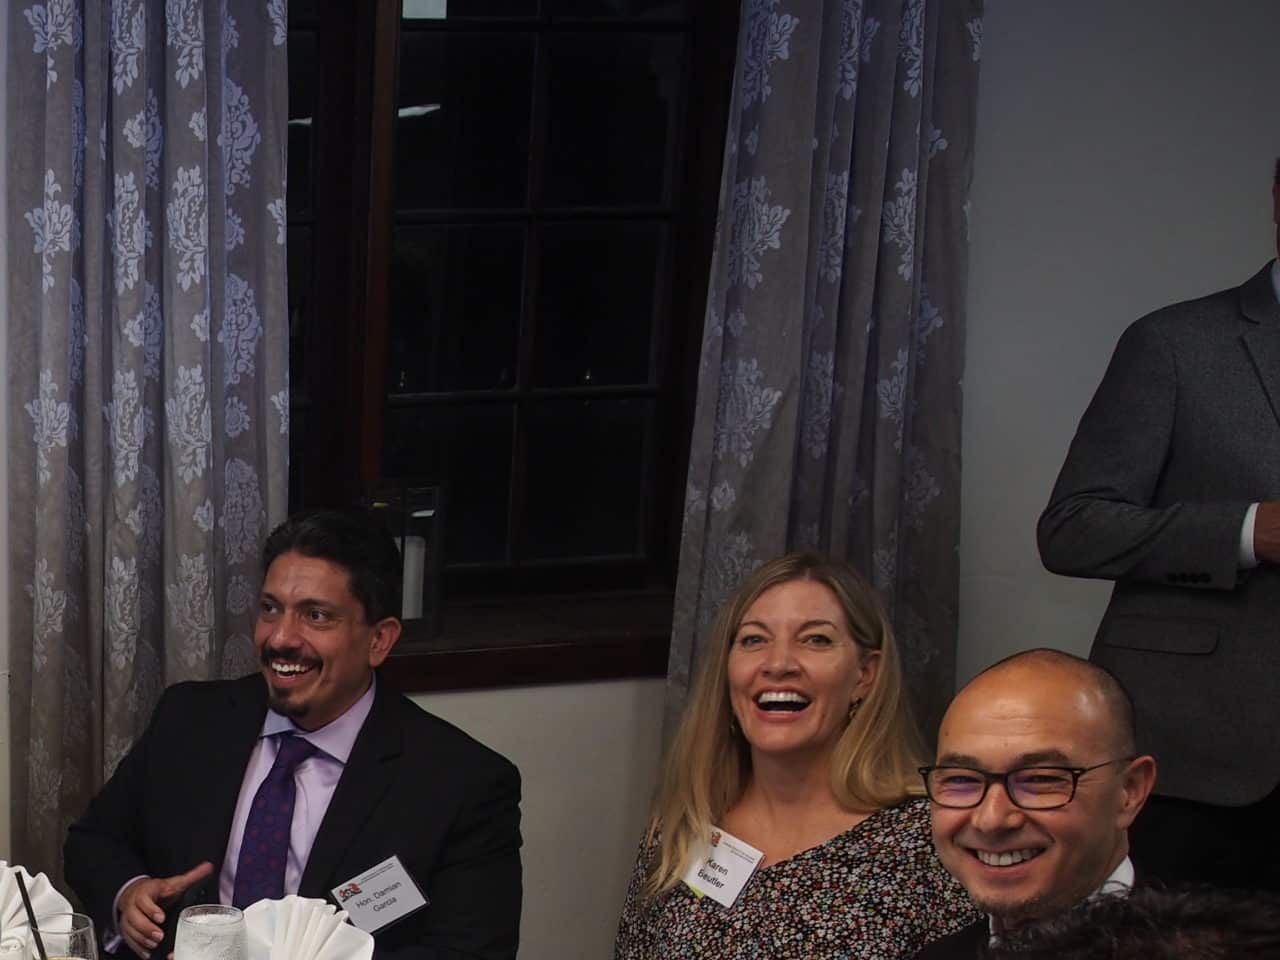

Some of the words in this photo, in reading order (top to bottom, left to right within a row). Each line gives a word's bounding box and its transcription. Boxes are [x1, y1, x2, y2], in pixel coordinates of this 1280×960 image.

[706, 857, 728, 876] Karen
[373, 881, 402, 899] Damian
[372, 897, 397, 912] Garcia
